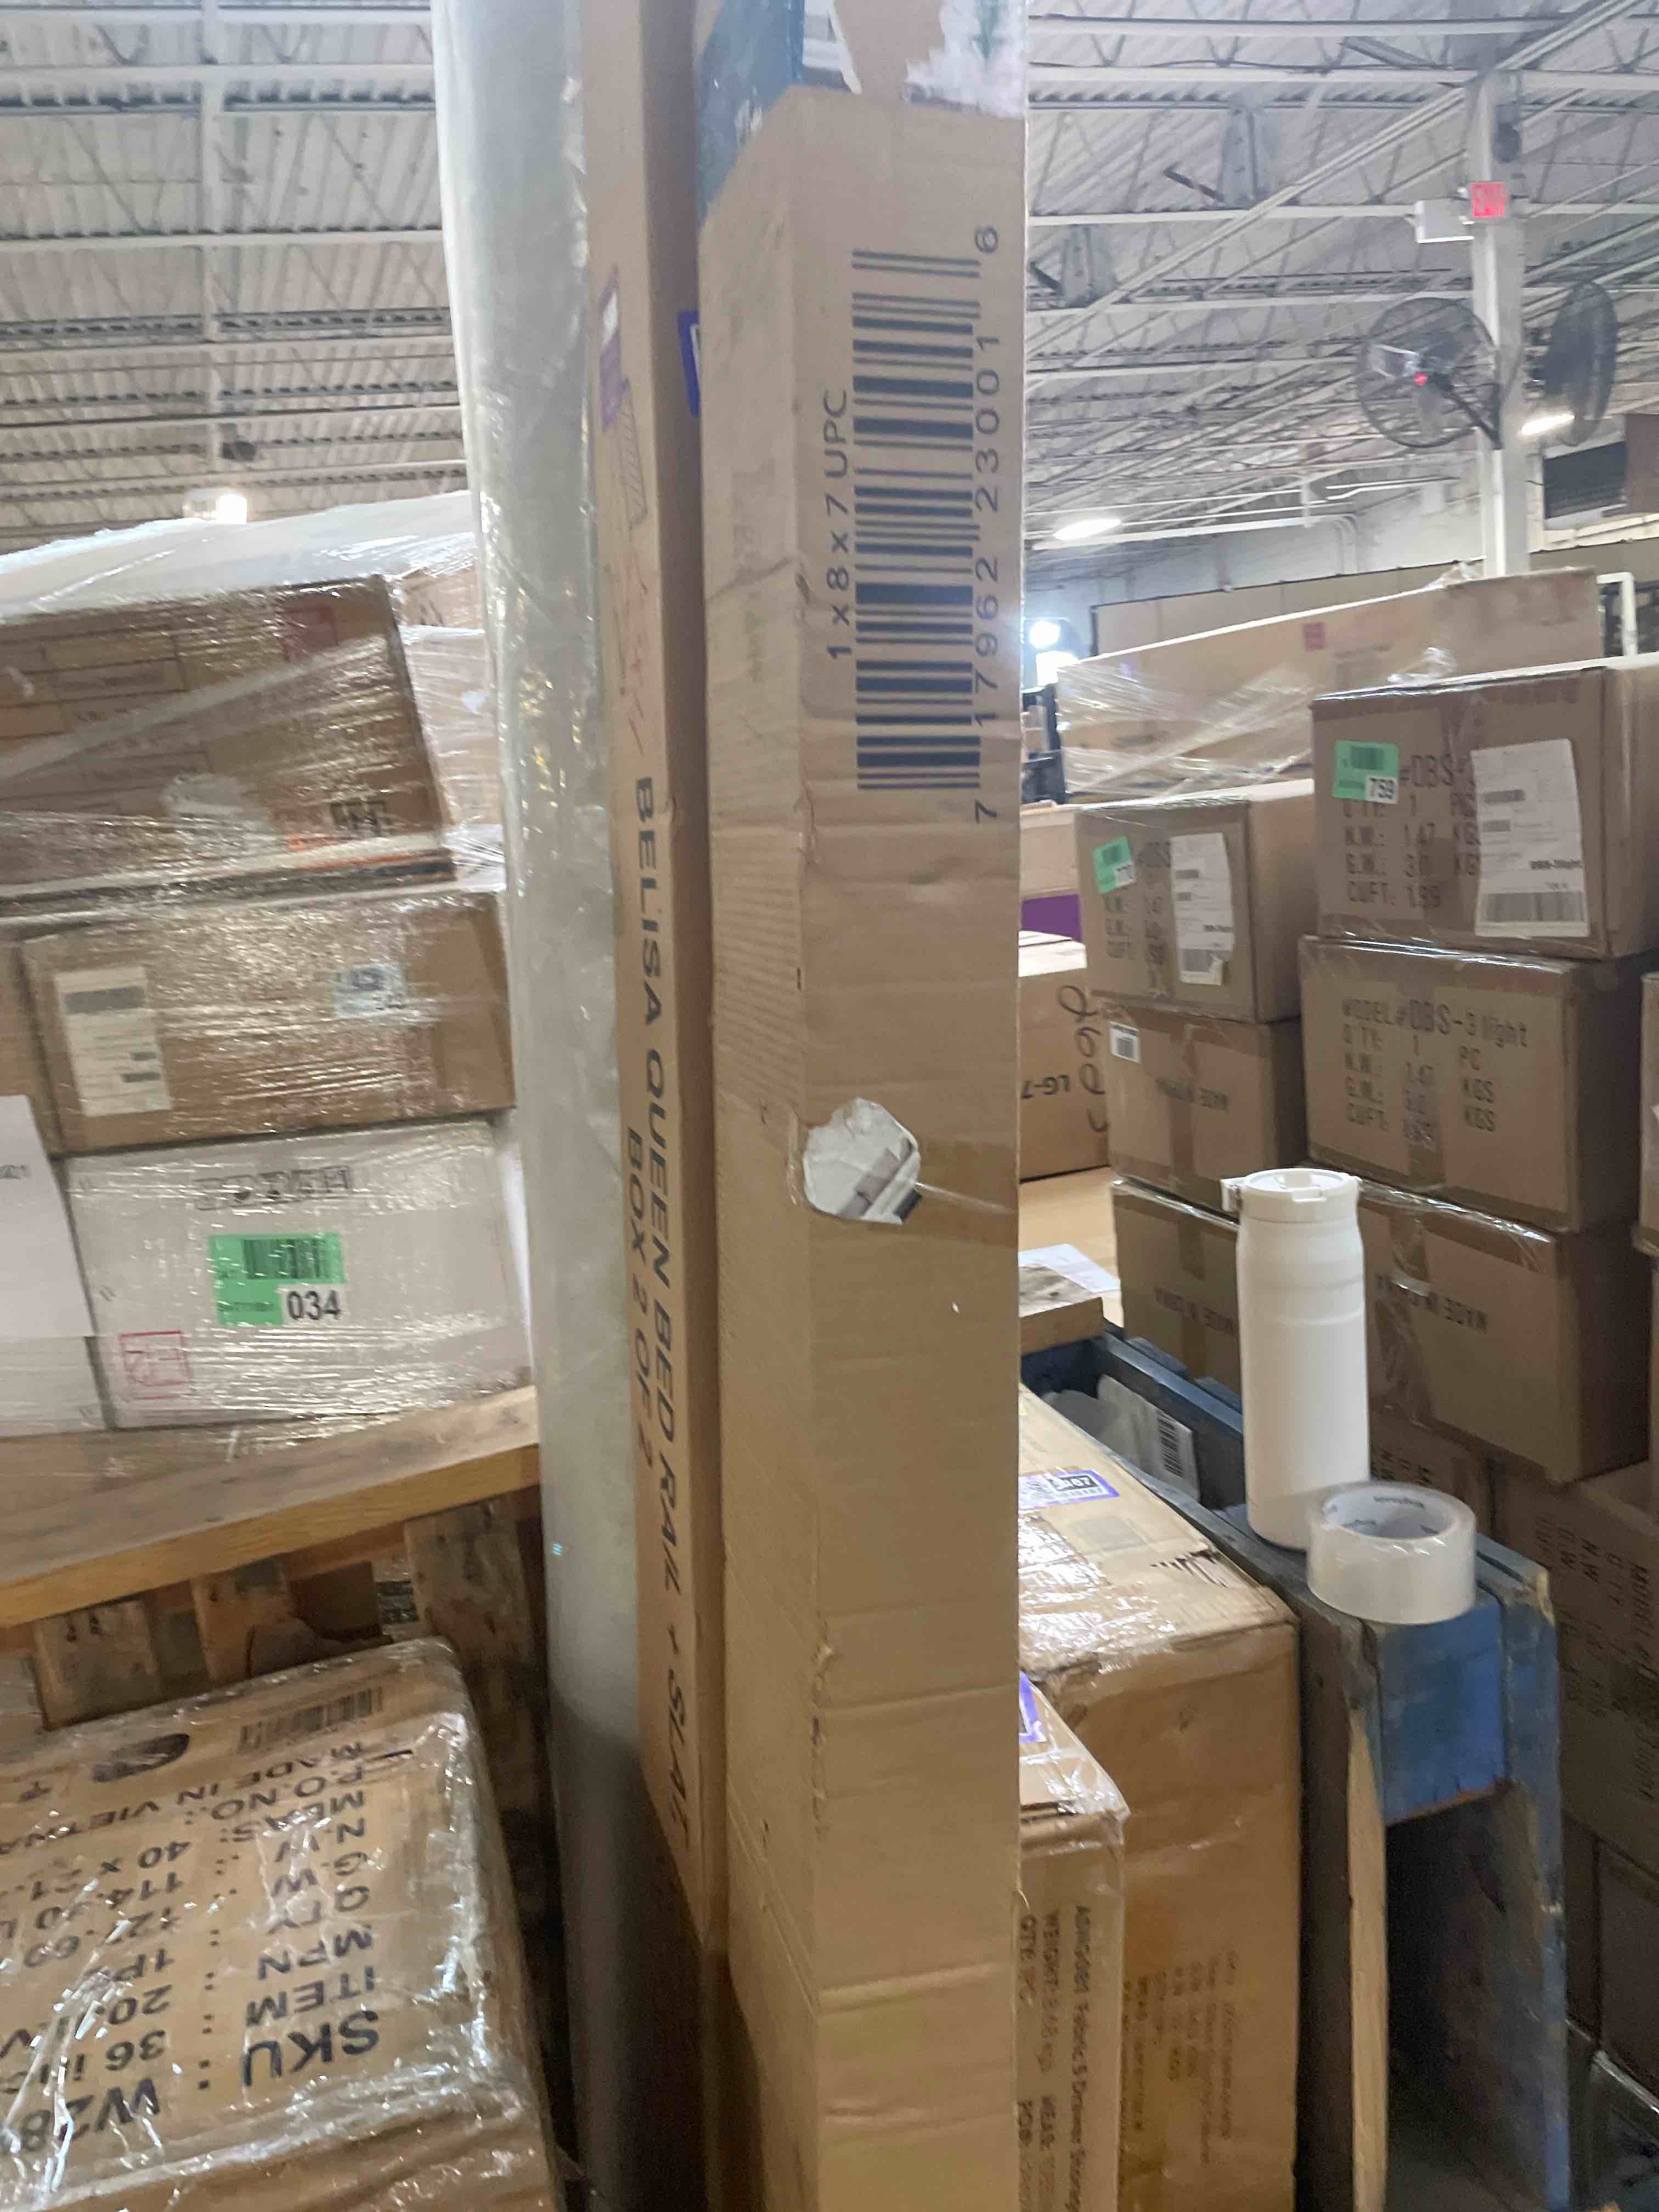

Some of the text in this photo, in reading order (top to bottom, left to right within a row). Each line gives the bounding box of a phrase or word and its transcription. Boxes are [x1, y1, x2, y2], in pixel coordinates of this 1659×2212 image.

[824, 389, 848, 479] UPC
[826, 495, 848, 517] 7
[827, 569, 848, 590] 8
[828, 645, 850, 658] 1
[635, 777, 664, 1026] BELISA
[646, 1048, 670, 1289] QUEEN
[287, 1290, 341, 1321] 034
[628, 1127, 654, 1469] BOX 2 OF 2
[654, 1299, 674, 1443] BED
[659, 1451, 681, 1595] RAIL
[176, 1784, 218, 1805] IN
[139, 1842, 190, 1869] 40
[258, 1929, 374, 1980] MPN
[245, 1966, 375, 2028] ITEM
[104, 2029, 166, 2071] 36
[241, 2010, 380, 2087] SKU
